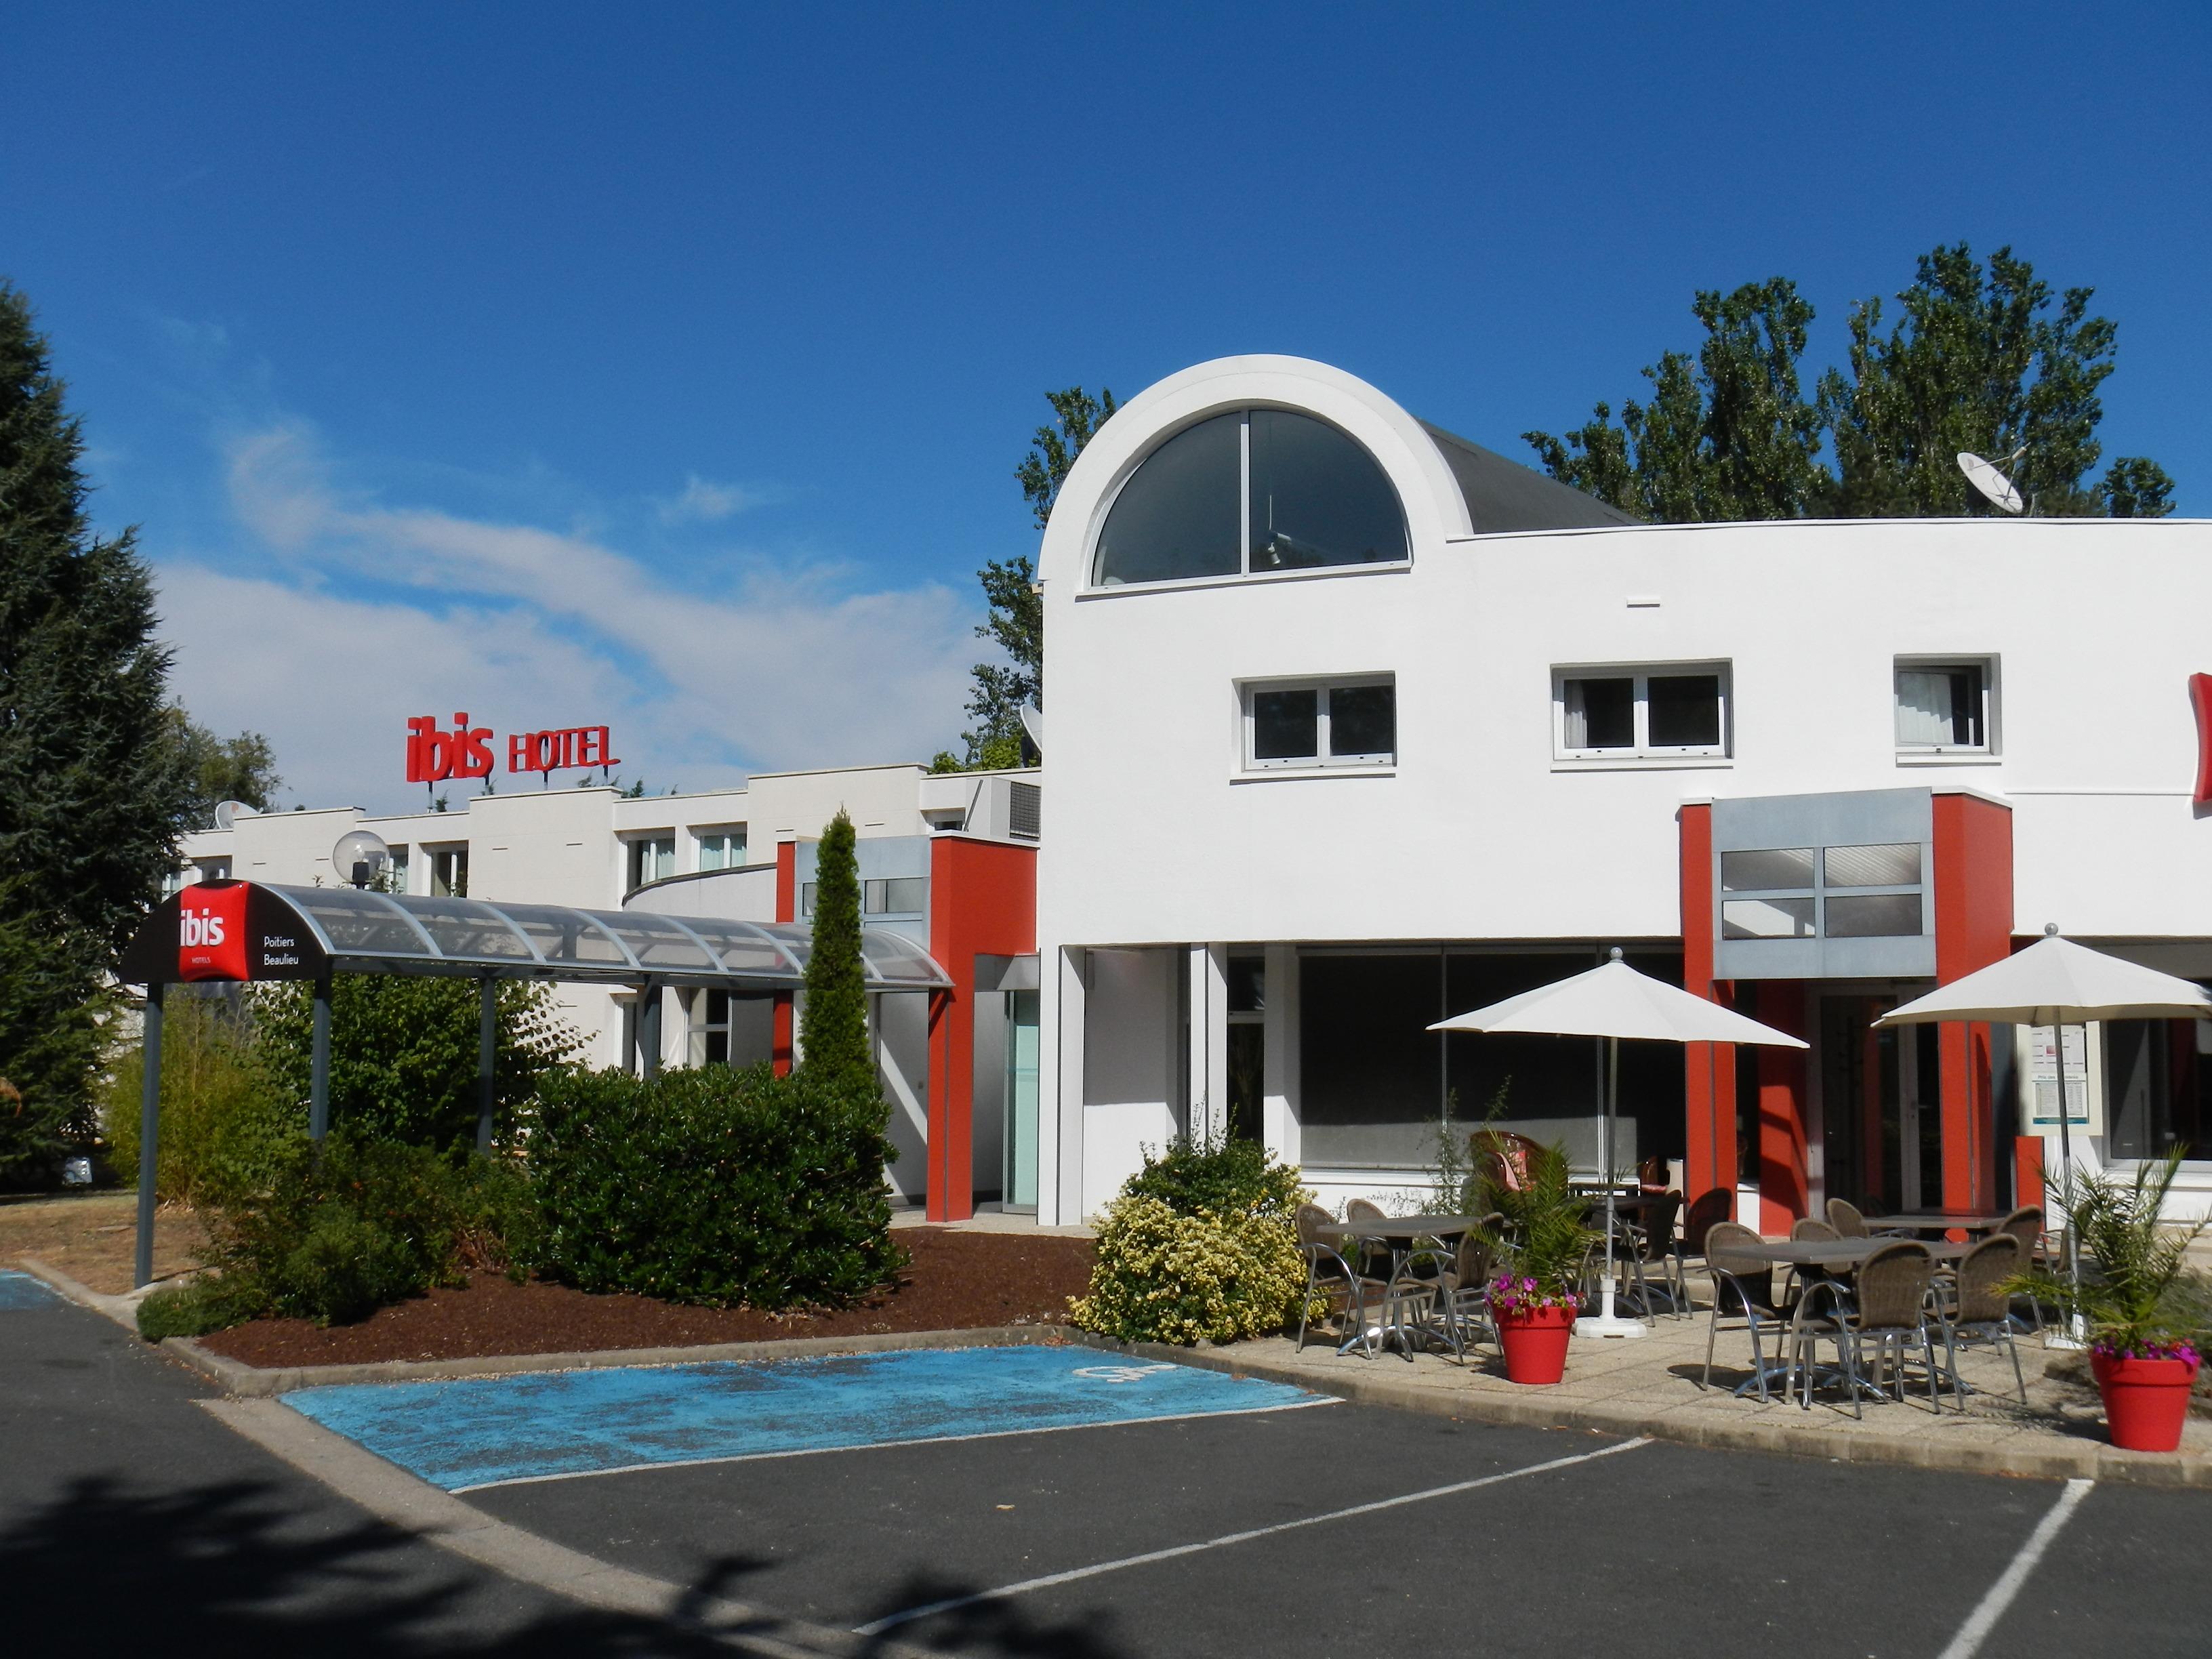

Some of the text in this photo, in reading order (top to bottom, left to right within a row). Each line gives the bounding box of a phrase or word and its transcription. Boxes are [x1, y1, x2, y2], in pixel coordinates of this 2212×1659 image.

[407, 712, 621, 782] ibis HOTEL
[180, 908, 224, 946] ibis
[264, 936, 294, 947] Poitiers
[264, 954, 299, 965] Beaulieu
